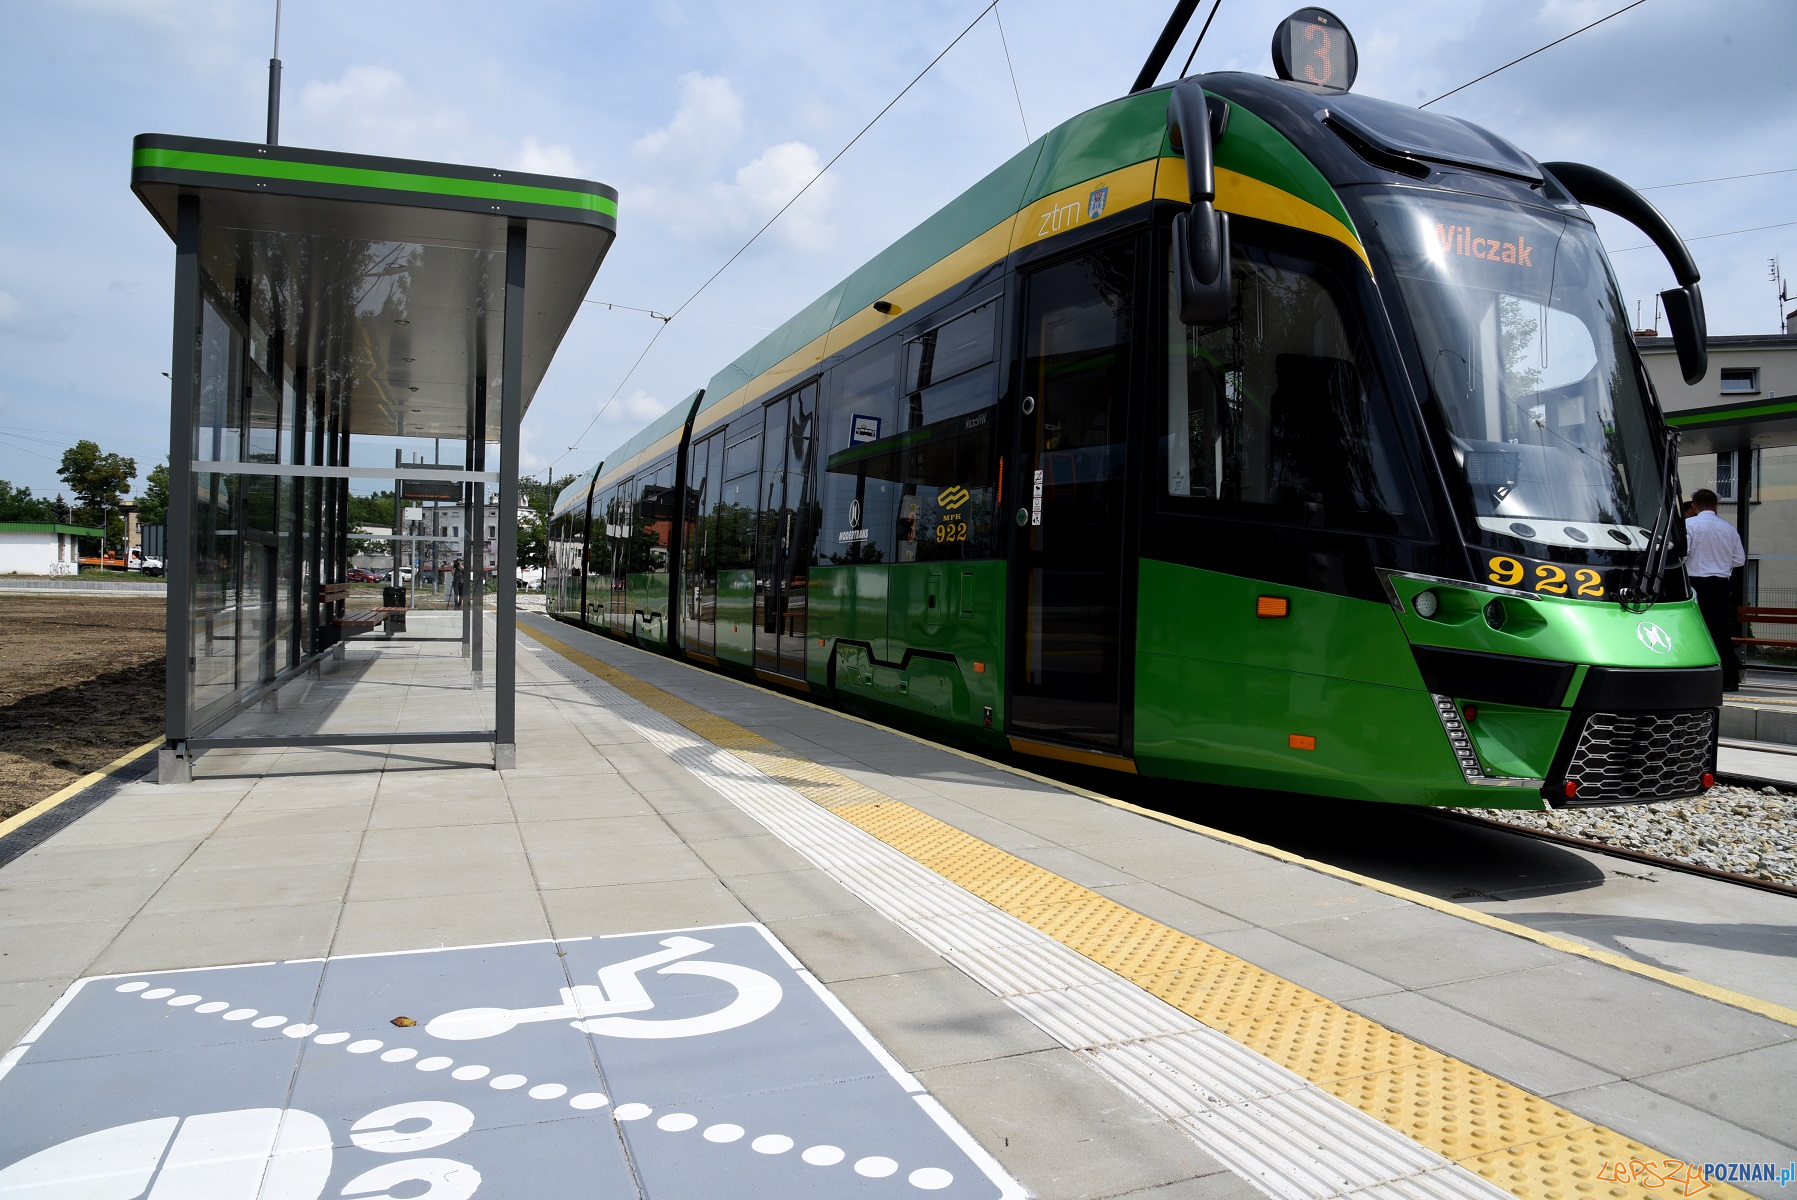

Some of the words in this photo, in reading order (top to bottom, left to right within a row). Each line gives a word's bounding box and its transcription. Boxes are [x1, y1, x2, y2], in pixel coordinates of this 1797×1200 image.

[1304, 24, 1332, 85] 3
[1037, 200, 1080, 237] ztm
[935, 522, 968, 543] 922
[942, 513, 962, 522] MPK
[1488, 556, 1605, 598] 922
